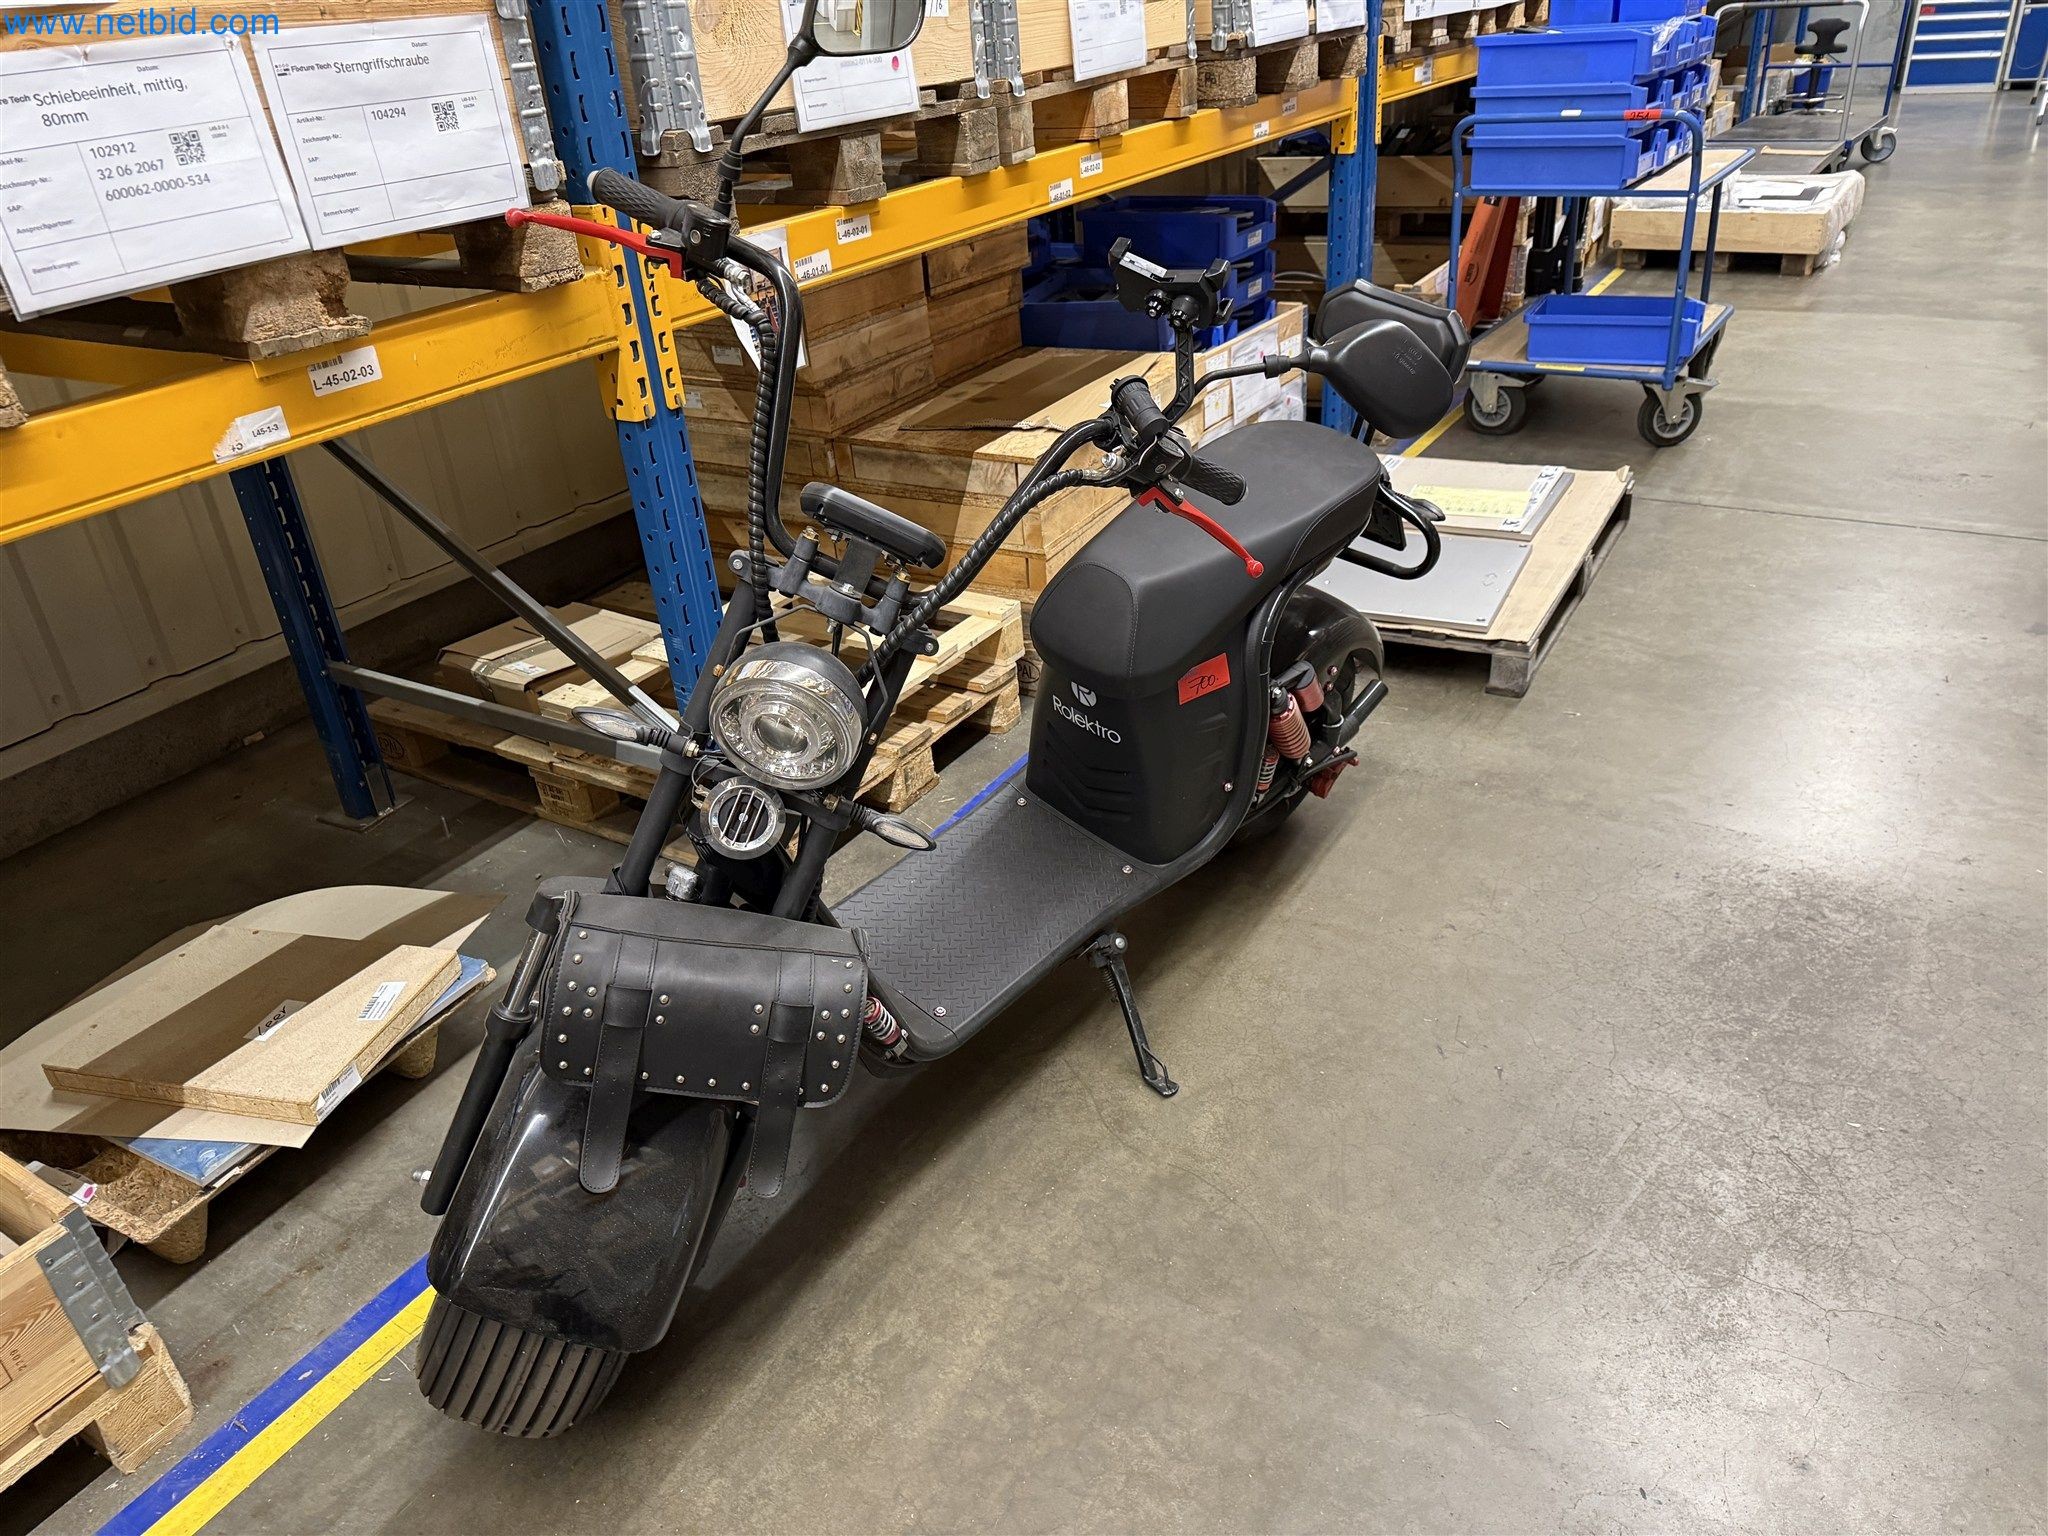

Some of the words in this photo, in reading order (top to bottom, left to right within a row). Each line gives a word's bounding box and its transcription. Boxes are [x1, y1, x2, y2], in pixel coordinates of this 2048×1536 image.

[315, 62, 332, 71] Tech
[333, 54, 430, 74] Sterngriffschraube
[8, 94, 31, 104] Tech
[33, 82, 141, 107] Schiebeeinheit,
[144, 77, 188, 94] mittig,
[41, 111, 89, 127] 80mm
[371, 107, 407, 121] 104294
[89, 141, 136, 160] 102912
[97, 166, 114, 181] 32
[116, 163, 133, 178] 06
[136, 158, 165, 175] 2067
[105, 173, 211, 202] 600062-0000-534
[838, 225, 868, 241] L-46-02-01
[313, 364, 374, 391] L-45-02-03
[251, 423, 279, 438] L45-1-3
[1052, 694, 1122, 744] Rolektro
